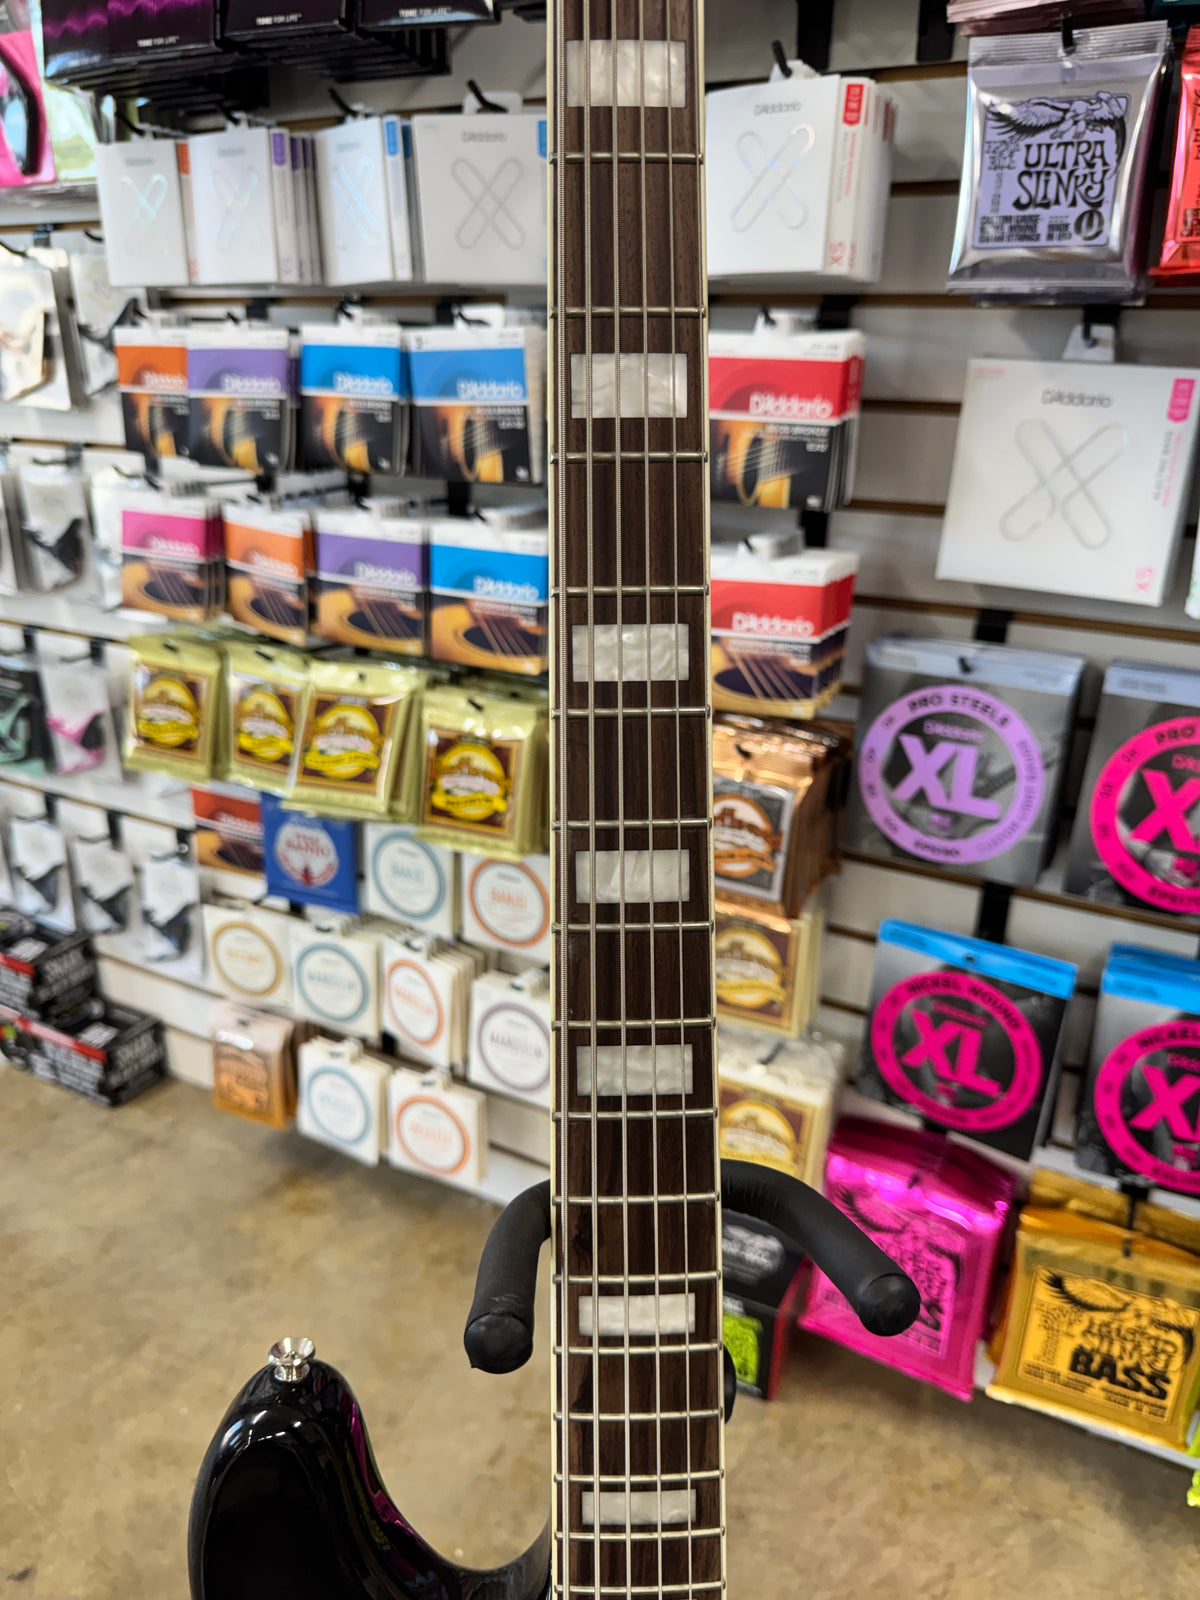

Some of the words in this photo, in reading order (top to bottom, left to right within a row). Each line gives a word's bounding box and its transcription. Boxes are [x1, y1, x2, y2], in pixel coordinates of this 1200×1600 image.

[1024, 140, 1110, 171] ULTRA
[750, 391, 833, 419] D'Addario
[732, 611, 815, 637] D'Addario
[907, 693, 944, 713] PRO
[951, 693, 1012, 730] STEELS
[1154, 723, 1197, 745] PRO
[891, 733, 1002, 821] XL
[1129, 768, 1200, 855] X
[900, 1006, 1003, 1098] XL
[1128, 1063, 1200, 1143] X
[1070, 1345, 1172, 1401] BASS
